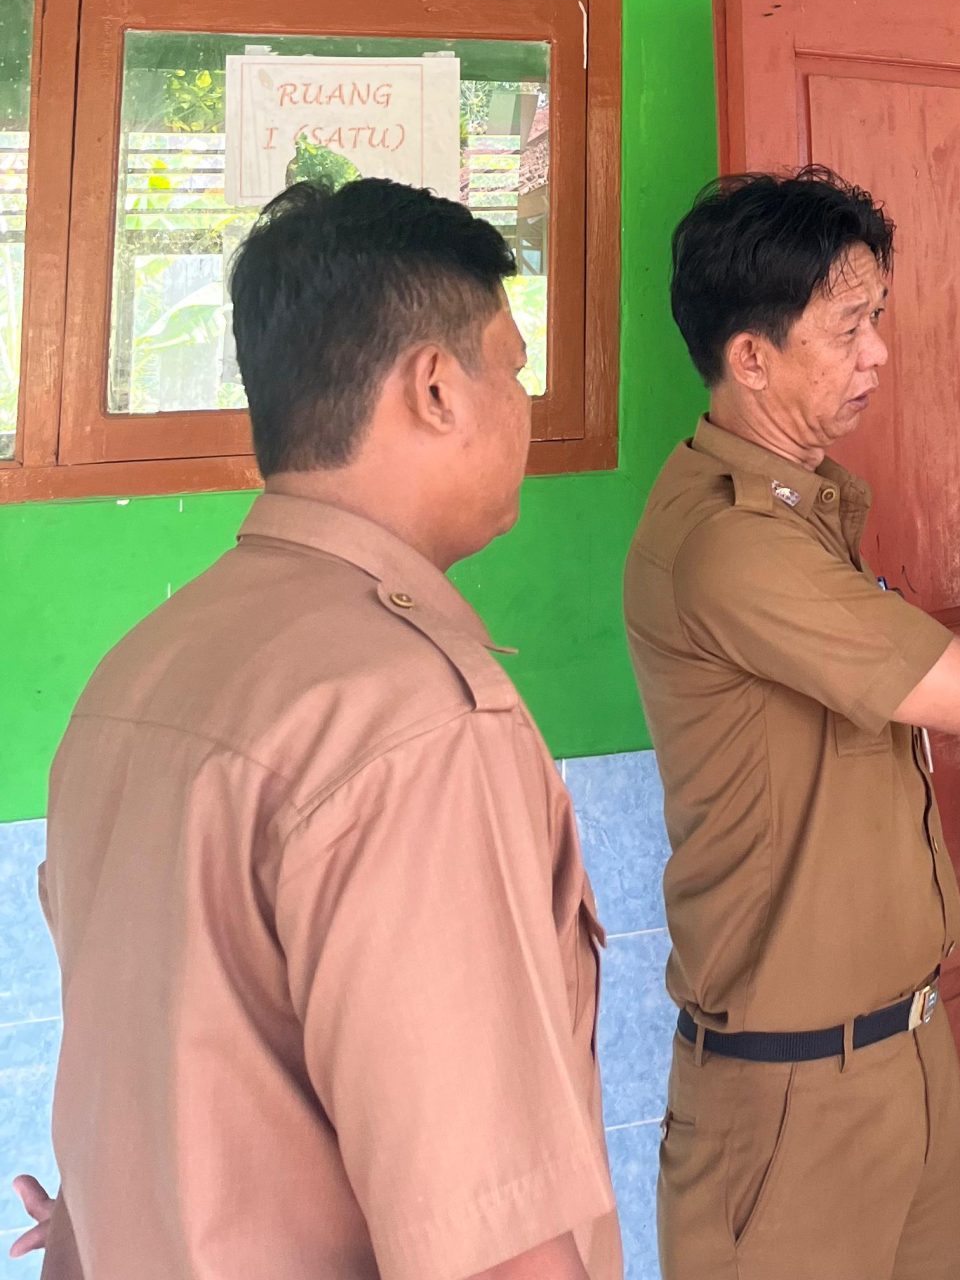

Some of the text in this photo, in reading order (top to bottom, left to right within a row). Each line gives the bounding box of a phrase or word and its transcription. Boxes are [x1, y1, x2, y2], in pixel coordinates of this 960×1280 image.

[277, 82, 393, 108] RUANG
[263, 123, 406, 152] I (SATU)
